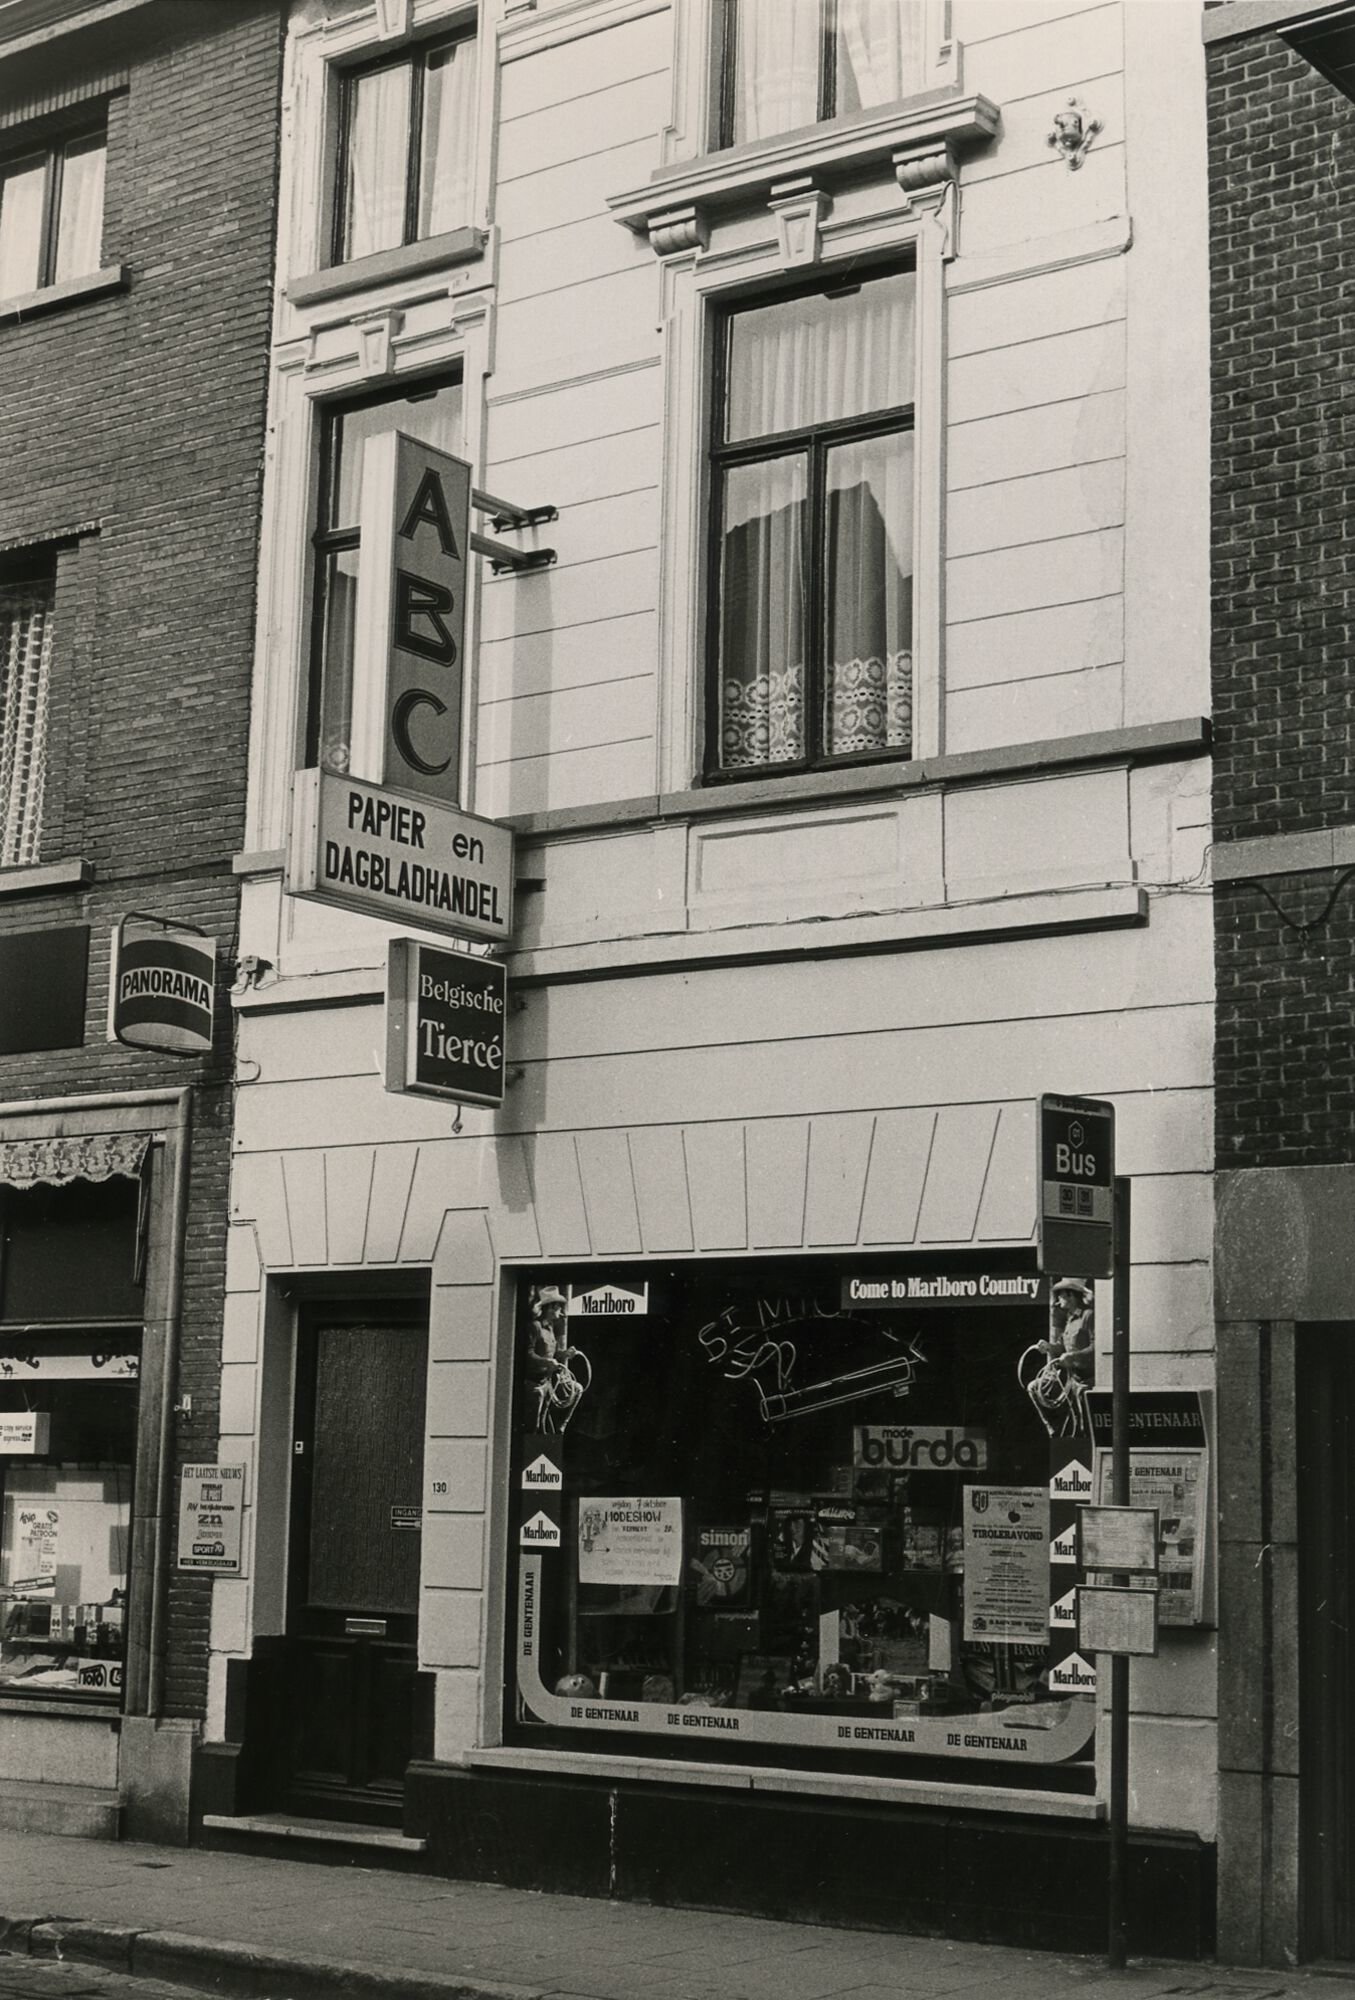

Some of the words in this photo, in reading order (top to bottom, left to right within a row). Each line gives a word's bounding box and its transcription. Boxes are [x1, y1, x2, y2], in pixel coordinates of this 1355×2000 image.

[392, 466, 460, 776] ABC
[348, 791, 426, 849] PAPIER
[452, 833, 484, 864] en
[325, 840, 503, 925] DAGBLADHANDEL
[122, 969, 211, 1010] PANORAMA
[420, 1018, 502, 1070] Tiercé
[1056, 1143, 1096, 1176] Bus
[850, 1279, 889, 1299] Come
[891, 1280, 906, 1297] to
[907, 1277, 976, 1297] Marlboro
[979, 1275, 1040, 1298] Country
[581, 1292, 635, 1314] Marlboro
[1094, 1412, 1113, 1428] DE
[1128, 1412, 1203, 1429] ENTENAAR
[882, 1428, 914, 1438] mode
[861, 1429, 978, 1468] burda
[195, 1467, 219, 1479] LAATSTE
[525, 1463, 560, 1483] Marlboro
[1054, 1470, 1091, 1492] Marlbor
[1134, 1466, 1183, 1477] GENTENAAR
[433, 1482, 446, 1493] 130
[198, 1514, 223, 1525] zn
[523, 1520, 558, 1540] Marlboro
[972, 1529, 1043, 1540] TIROLERAVOND
[194, 1546, 214, 1554] SPORT
[1054, 1534, 1076, 1556] Marl
[524, 1571, 535, 1638] GENTENAAR
[1054, 1599, 1077, 1620] Marl
[524, 1639, 533, 1656] DE
[1053, 1663, 1096, 1686] Marlboro
[571, 1707, 583, 1719] DE
[585, 1708, 639, 1722] GENTENAAR
[667, 1713, 680, 1725] DE
[682, 1714, 740, 1730] GENTENAAR
[838, 1726, 851, 1738] DE
[854, 1727, 915, 1742] GENTENAAR
[947, 1733, 961, 1746] DE
[964, 1735, 1028, 1751] GENTENAAR
